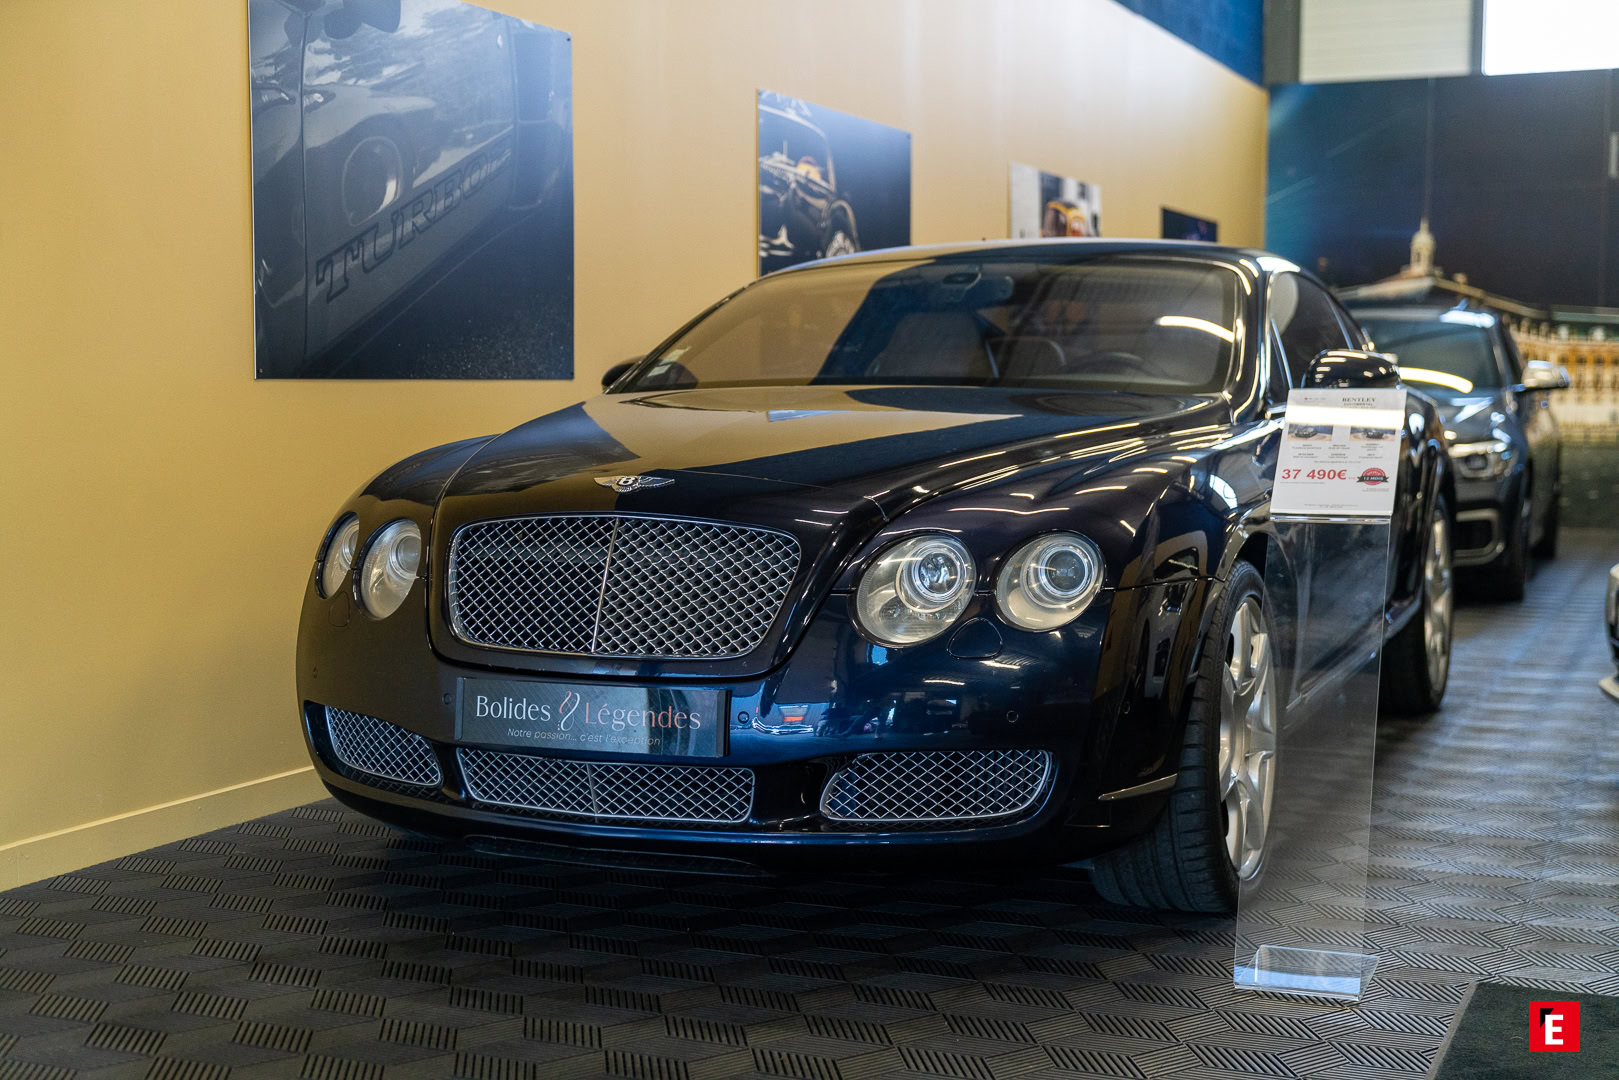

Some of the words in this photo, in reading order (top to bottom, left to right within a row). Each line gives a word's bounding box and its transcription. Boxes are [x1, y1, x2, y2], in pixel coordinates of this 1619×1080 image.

[316, 152, 488, 303] TURBO
[1281, 468, 1302, 480] 37
[1306, 469, 1348, 480] 490€
[476, 695, 551, 721] Bolides
[585, 702, 701, 732] Légendes
[507, 728, 532, 738] Notre
[534, 730, 577, 740] passion...
[580, 733, 603, 743] c'est
[605, 734, 661, 746] l'exception
